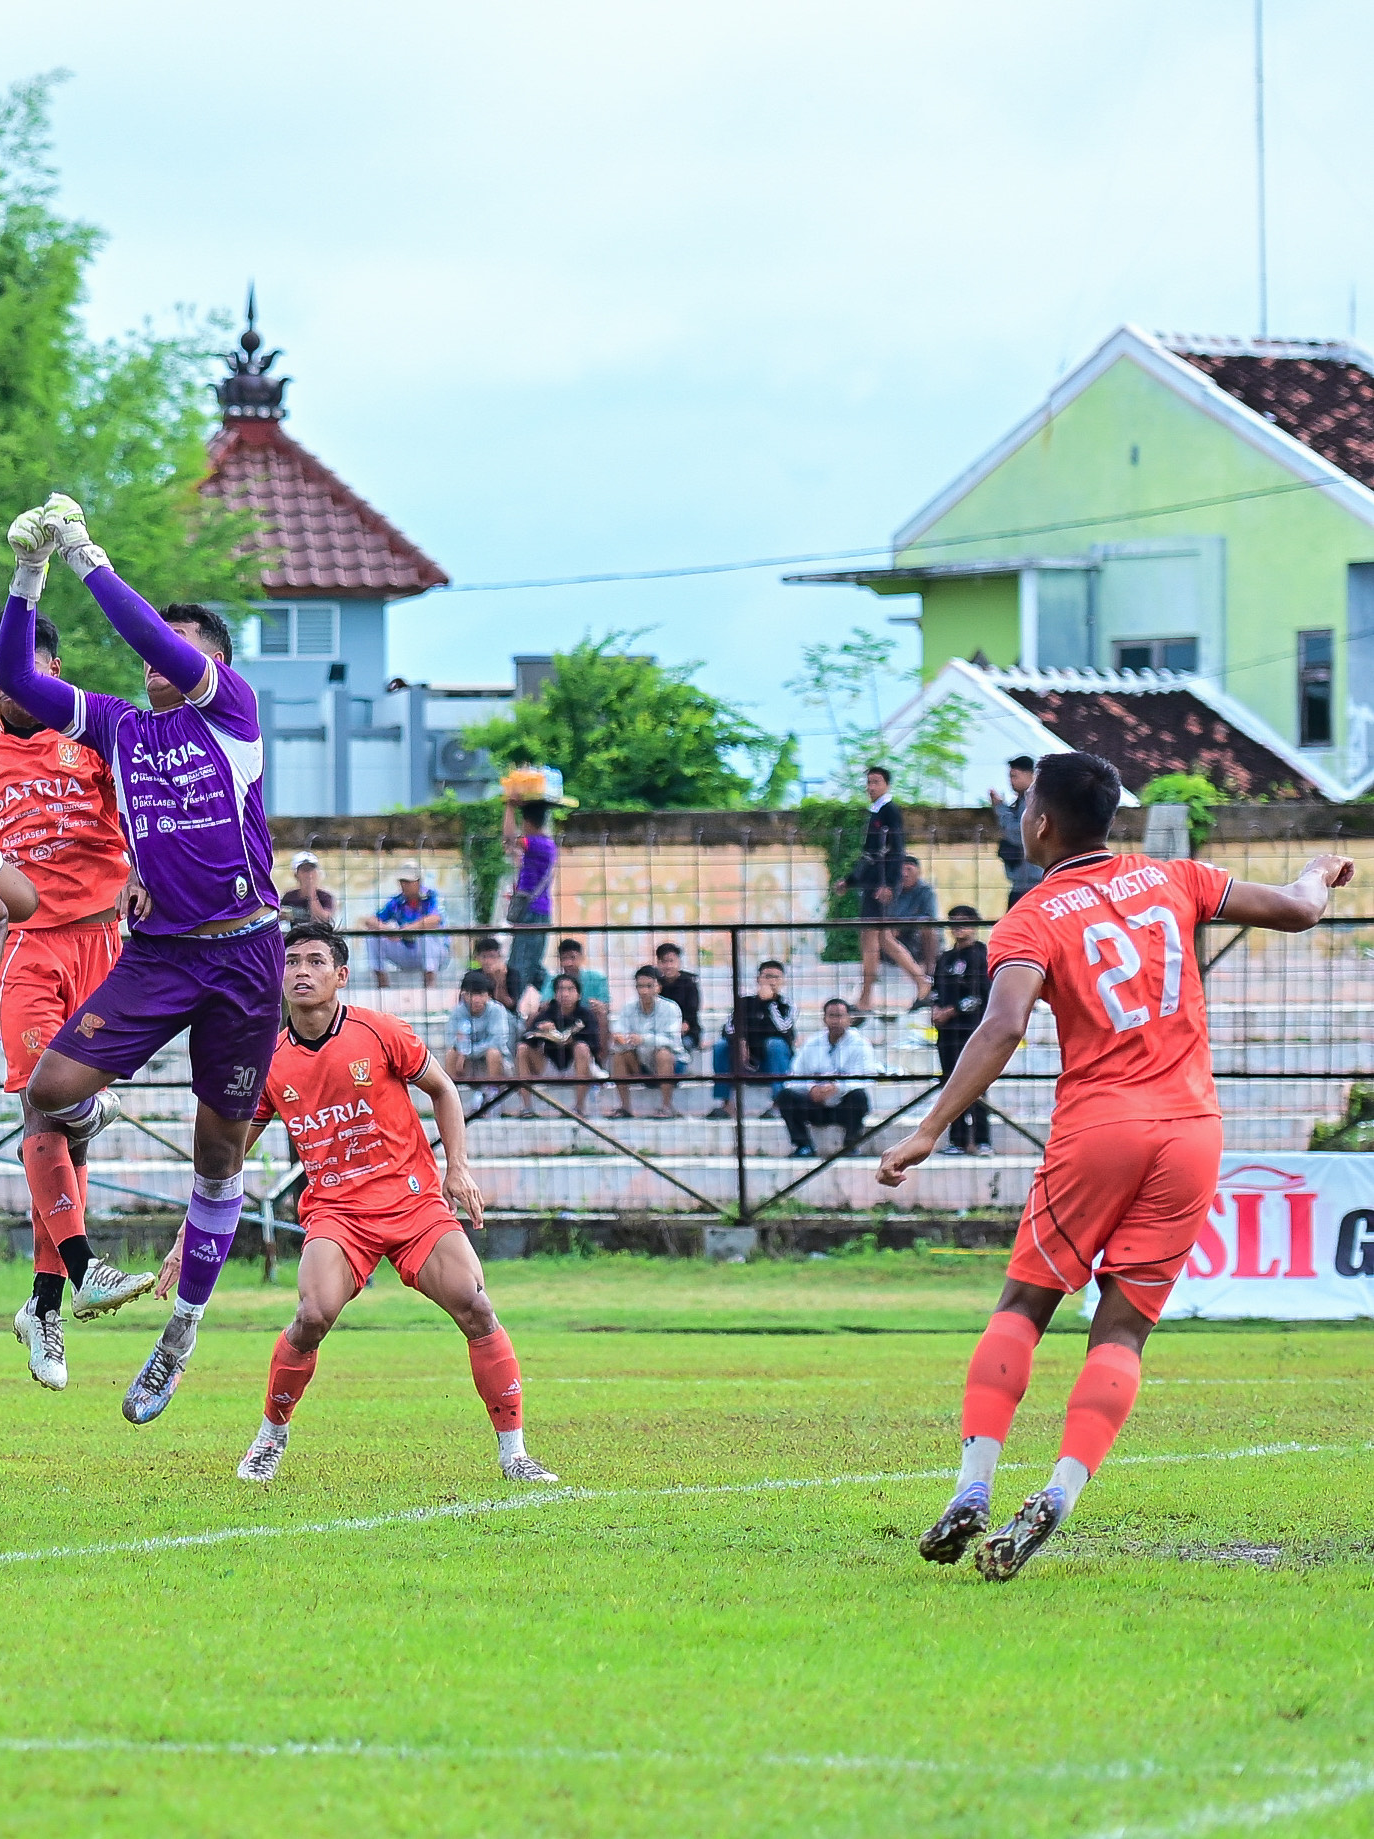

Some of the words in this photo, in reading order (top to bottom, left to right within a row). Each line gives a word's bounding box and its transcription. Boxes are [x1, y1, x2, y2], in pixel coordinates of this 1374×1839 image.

[1039, 885, 1101, 920] SATRIA
[1082, 905, 1183, 1034] 27
[227, 1065, 257, 1090] 30
[288, 1098, 374, 1136] SAFRIA
[1187, 1193, 1319, 1278] SLI
